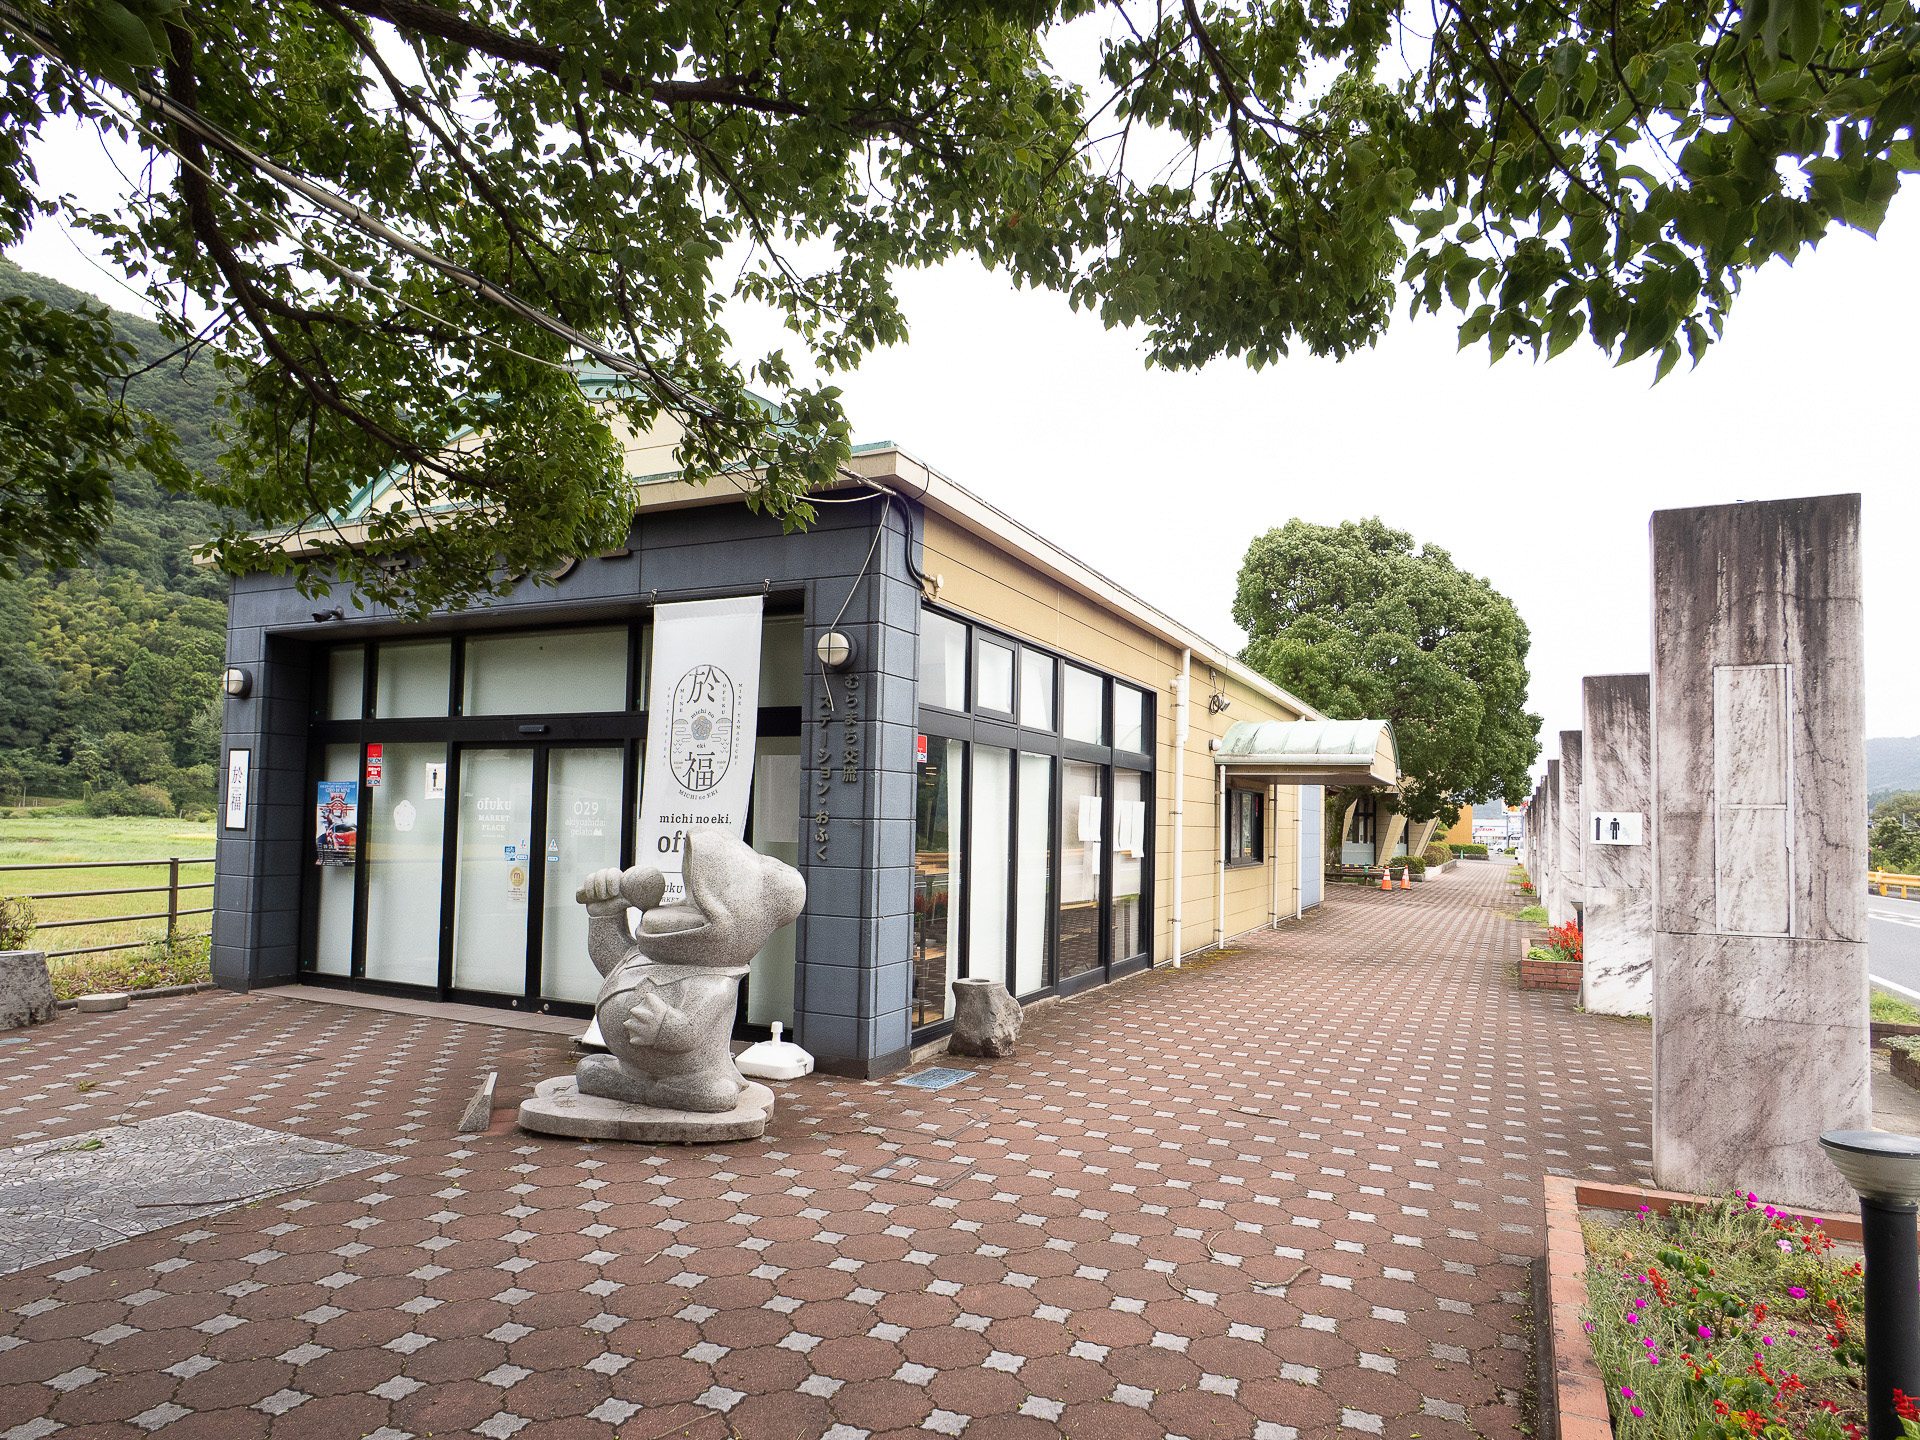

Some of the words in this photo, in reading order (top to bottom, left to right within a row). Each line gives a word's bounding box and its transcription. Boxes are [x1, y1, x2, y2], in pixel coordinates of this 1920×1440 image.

[687, 665, 720, 703] 於
[690, 708, 707, 719] michi
[682, 751, 716, 790] 福
[678, 789, 698, 800] MICHI
[706, 789, 719, 798] EKI
[478, 814, 510, 822] MARKET
[564, 816, 606, 828] akiyoshidai
[659, 813, 693, 824] michi
[570, 827, 593, 837] gelato
